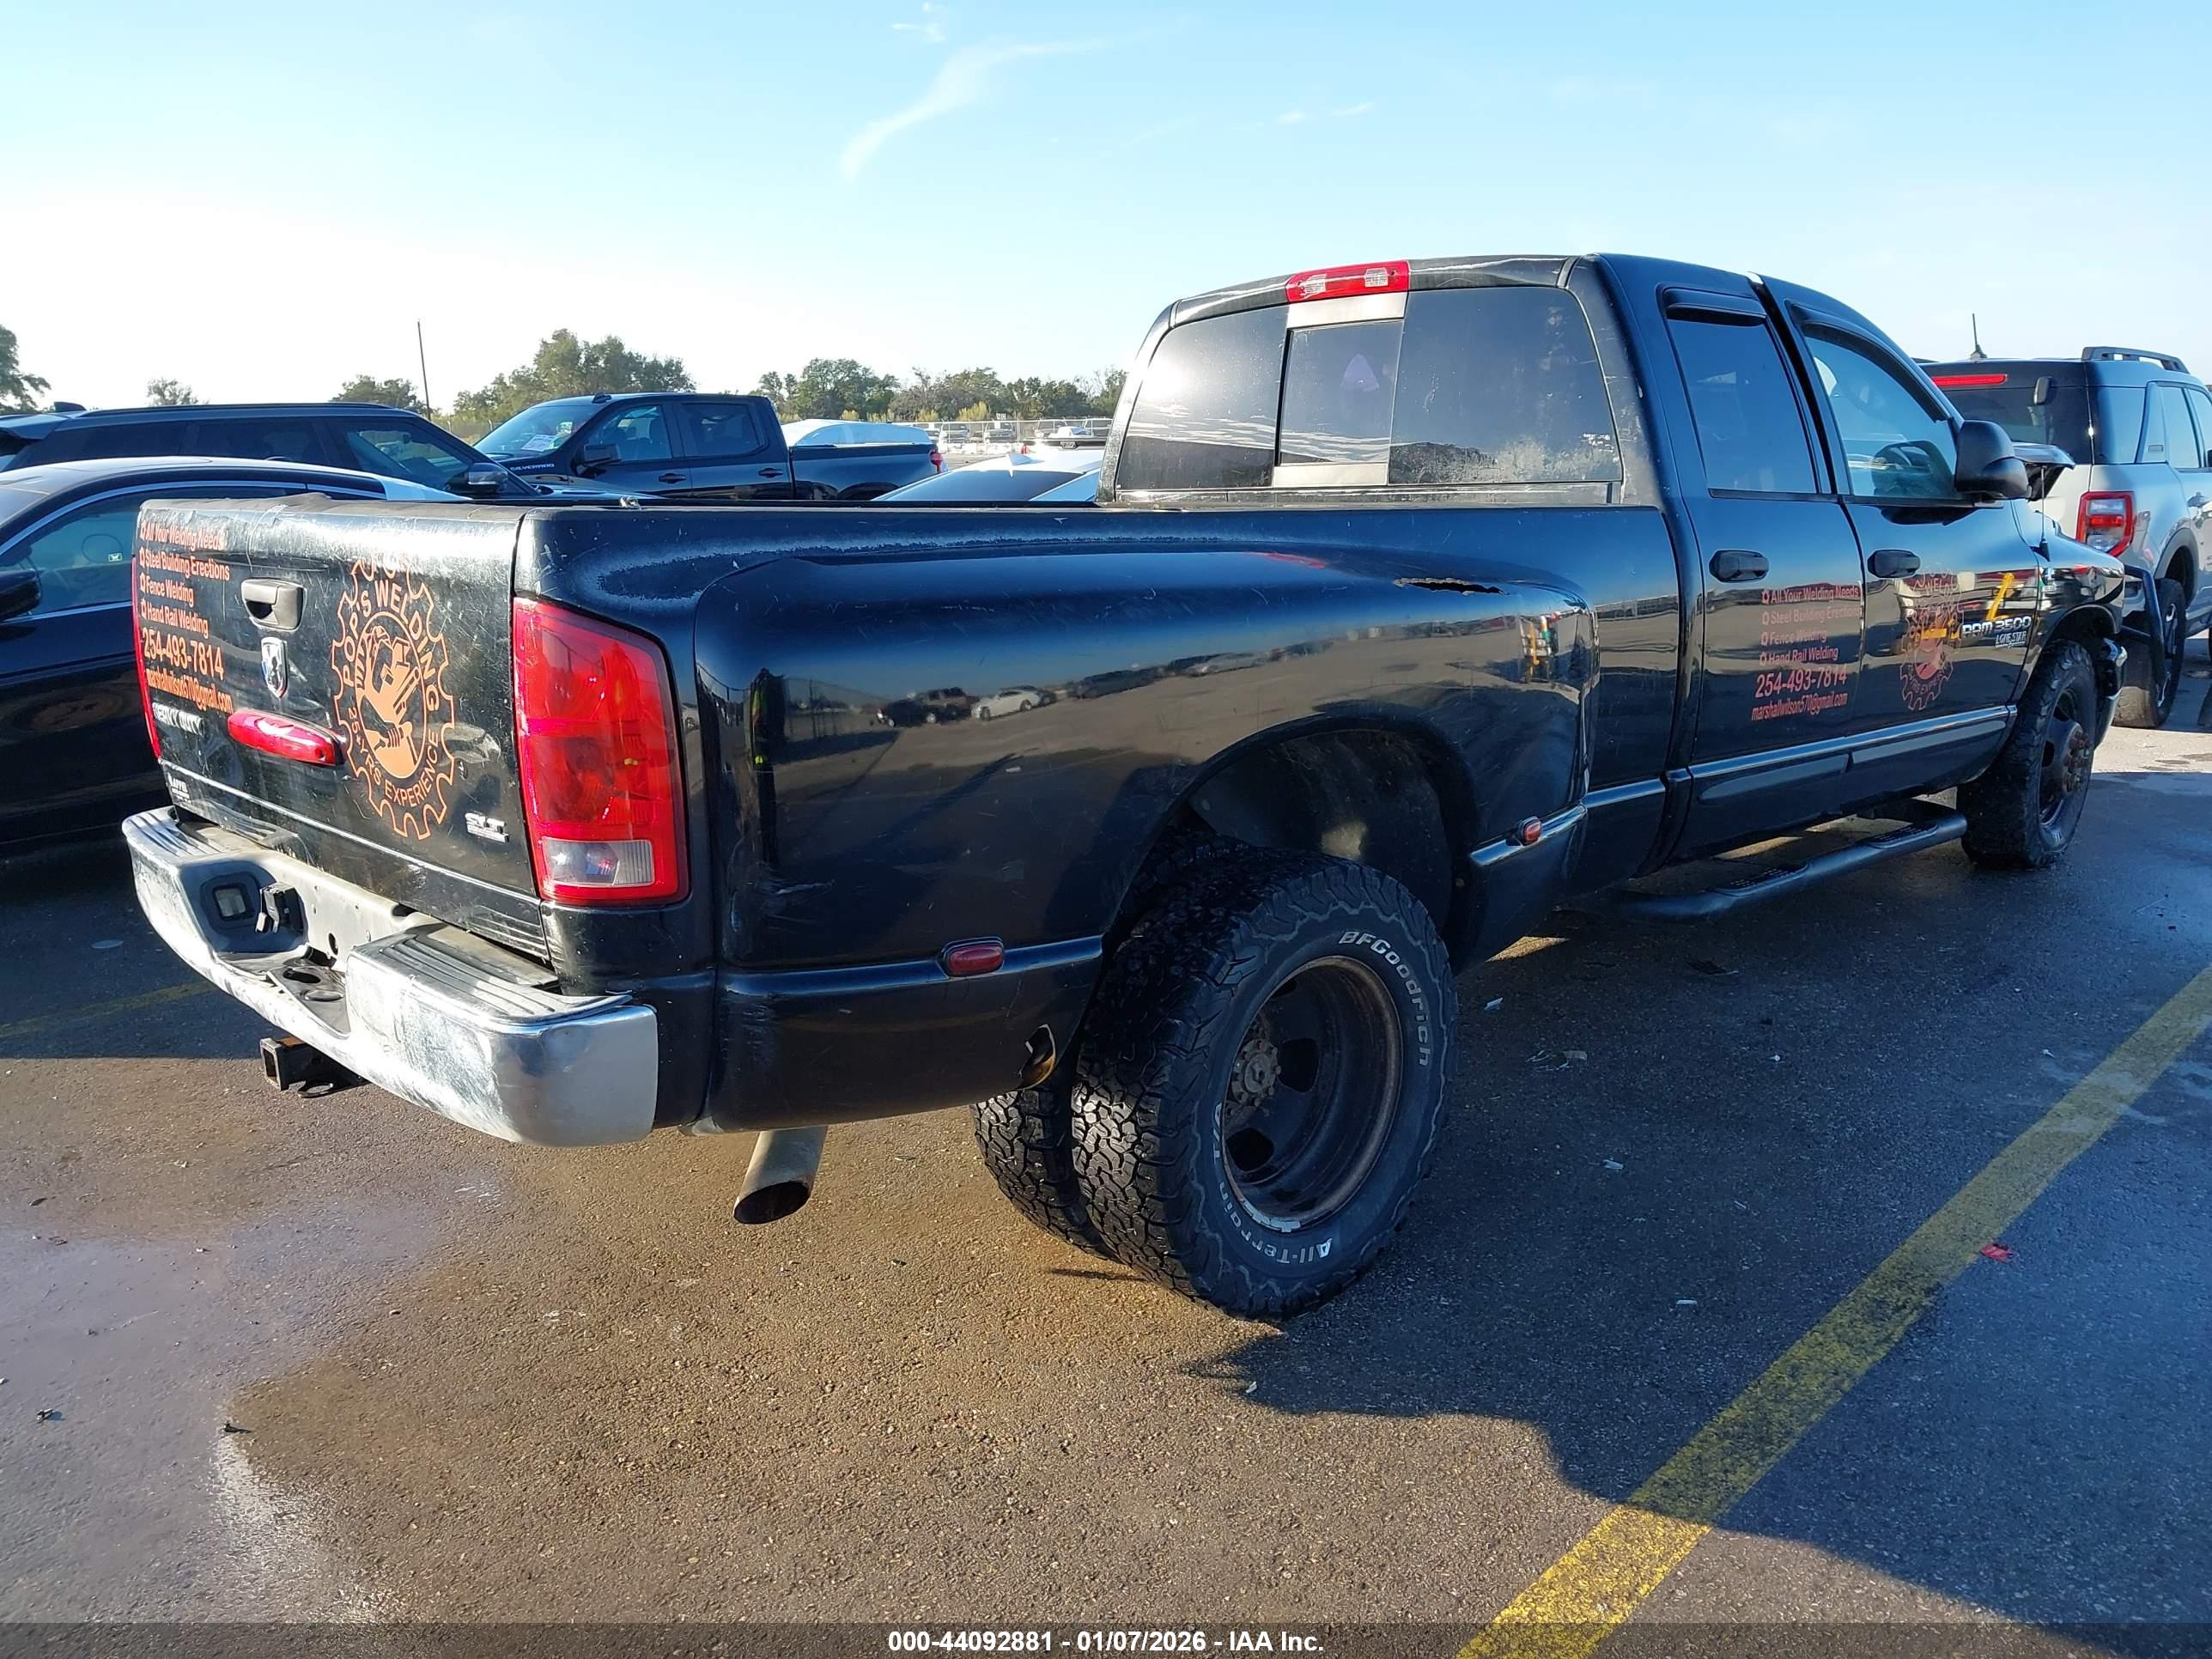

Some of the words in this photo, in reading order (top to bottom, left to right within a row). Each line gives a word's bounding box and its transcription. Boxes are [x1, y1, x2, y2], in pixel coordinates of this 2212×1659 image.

[145, 522, 154, 541] All
[155, 524, 170, 544] Your
[169, 525, 197, 551] Welding
[198, 527, 225, 550] Needs
[145, 548, 161, 569] Steel
[161, 551, 190, 579] Building
[190, 556, 230, 581] Erections
[145, 574, 165, 597] Fence
[165, 579, 194, 607] Welding
[1771, 590, 1782, 603] All
[1784, 589, 1802, 603] Your
[1803, 587, 1834, 603] Welding
[1835, 585, 1860, 599] Needs
[147, 601, 165, 623] Hand
[164, 605, 179, 627] Rail
[178, 608, 209, 639] Welding
[1771, 611, 1793, 624] Steel
[1794, 608, 1826, 623] Building
[1962, 621, 1993, 639] RAM
[1994, 616, 2032, 632] 3500
[142, 627, 224, 681] 254-493-7814
[374, 579, 439, 711] WELDING
[1770, 631, 1795, 646] Fence
[1796, 629, 1827, 643] Welding
[1768, 652, 1790, 665] Hand
[1792, 648, 1808, 662] Rail
[1808, 646, 1839, 660] Welding
[1754, 665, 1848, 698] 254-493-7814
[179, 710, 204, 737] DUTY
[385, 728, 439, 808] EXPERIENCE
[1338, 931, 1431, 1066] BFGoodrich
[1218, 1181, 1333, 1264] All-Terrain
